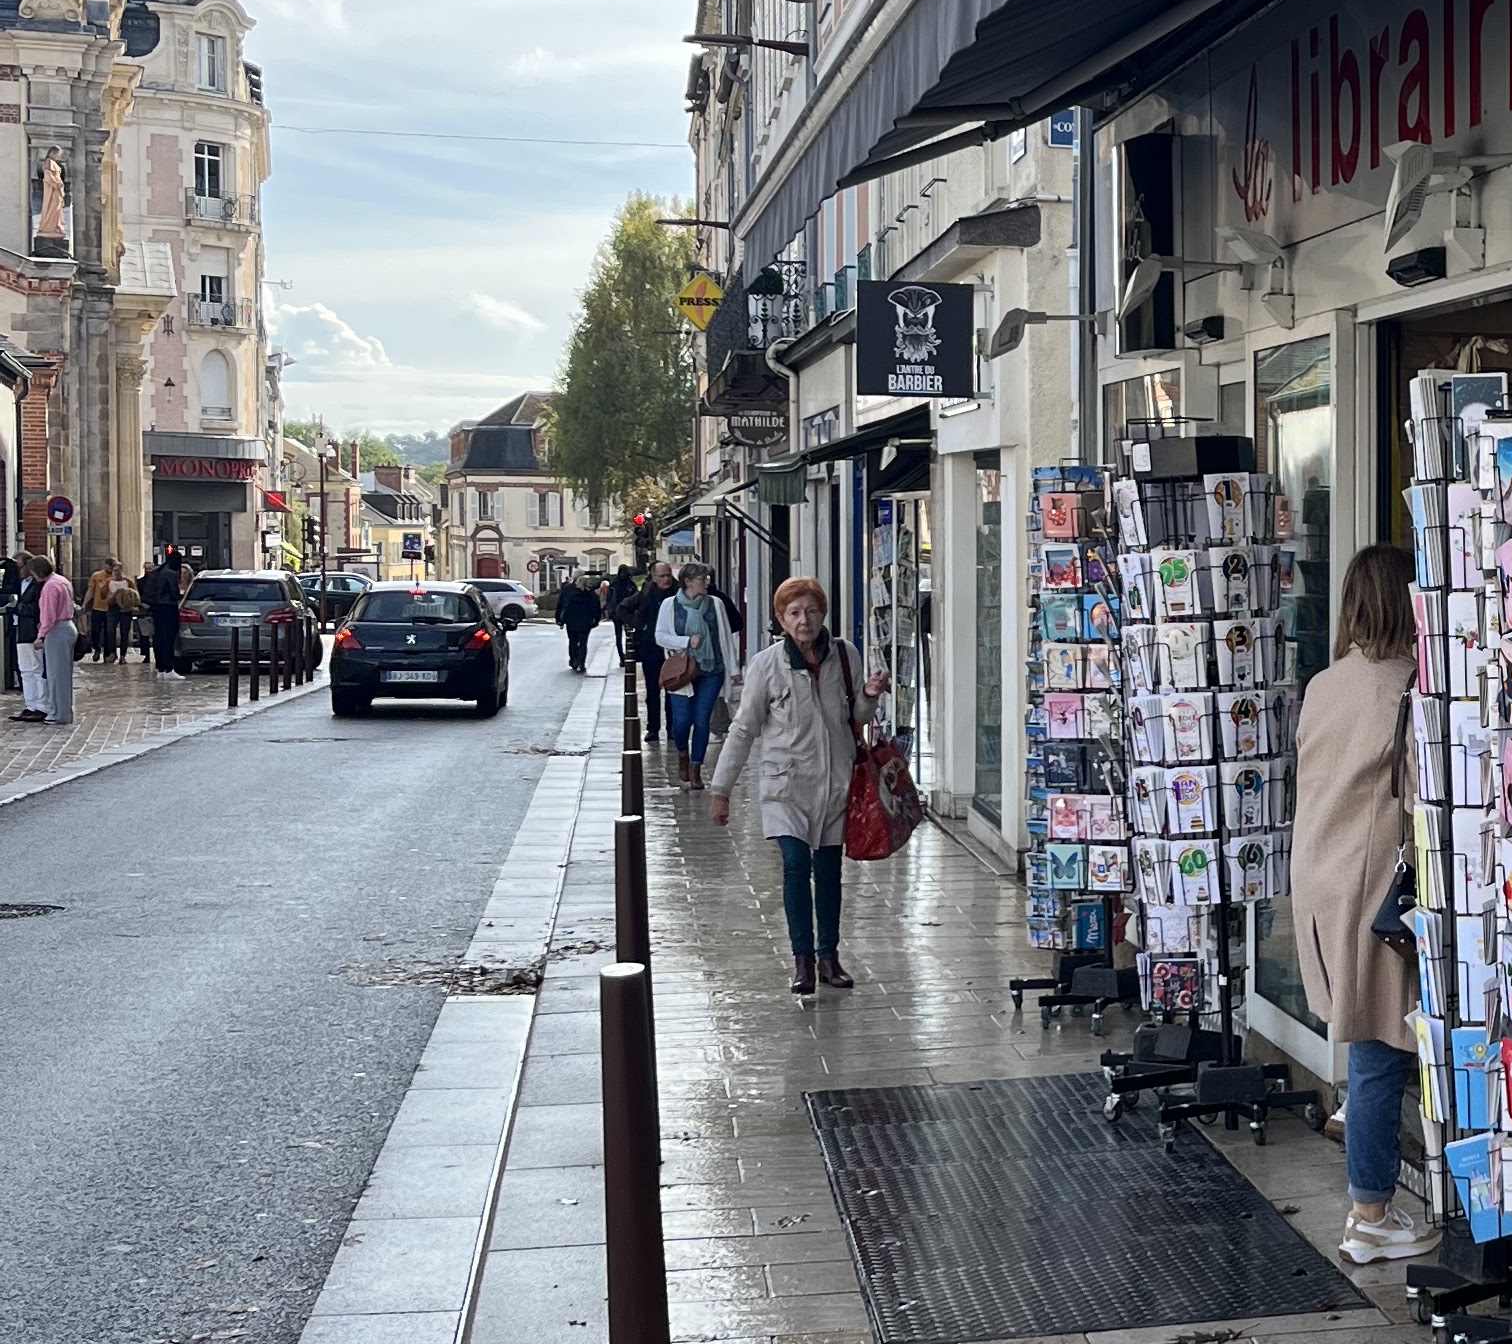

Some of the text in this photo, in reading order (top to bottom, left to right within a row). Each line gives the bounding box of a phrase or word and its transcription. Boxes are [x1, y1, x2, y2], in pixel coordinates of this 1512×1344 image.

[1057, 121, 1074, 133] CO
[1233, 63, 1272, 223] la
[679, 296, 723, 306] PRESS
[896, 364, 935, 375] L'ANTRE DU
[888, 373, 943, 391] BARBIER
[731, 416, 785, 428] MATHILDE
[160, 457, 260, 480] MONOPR
